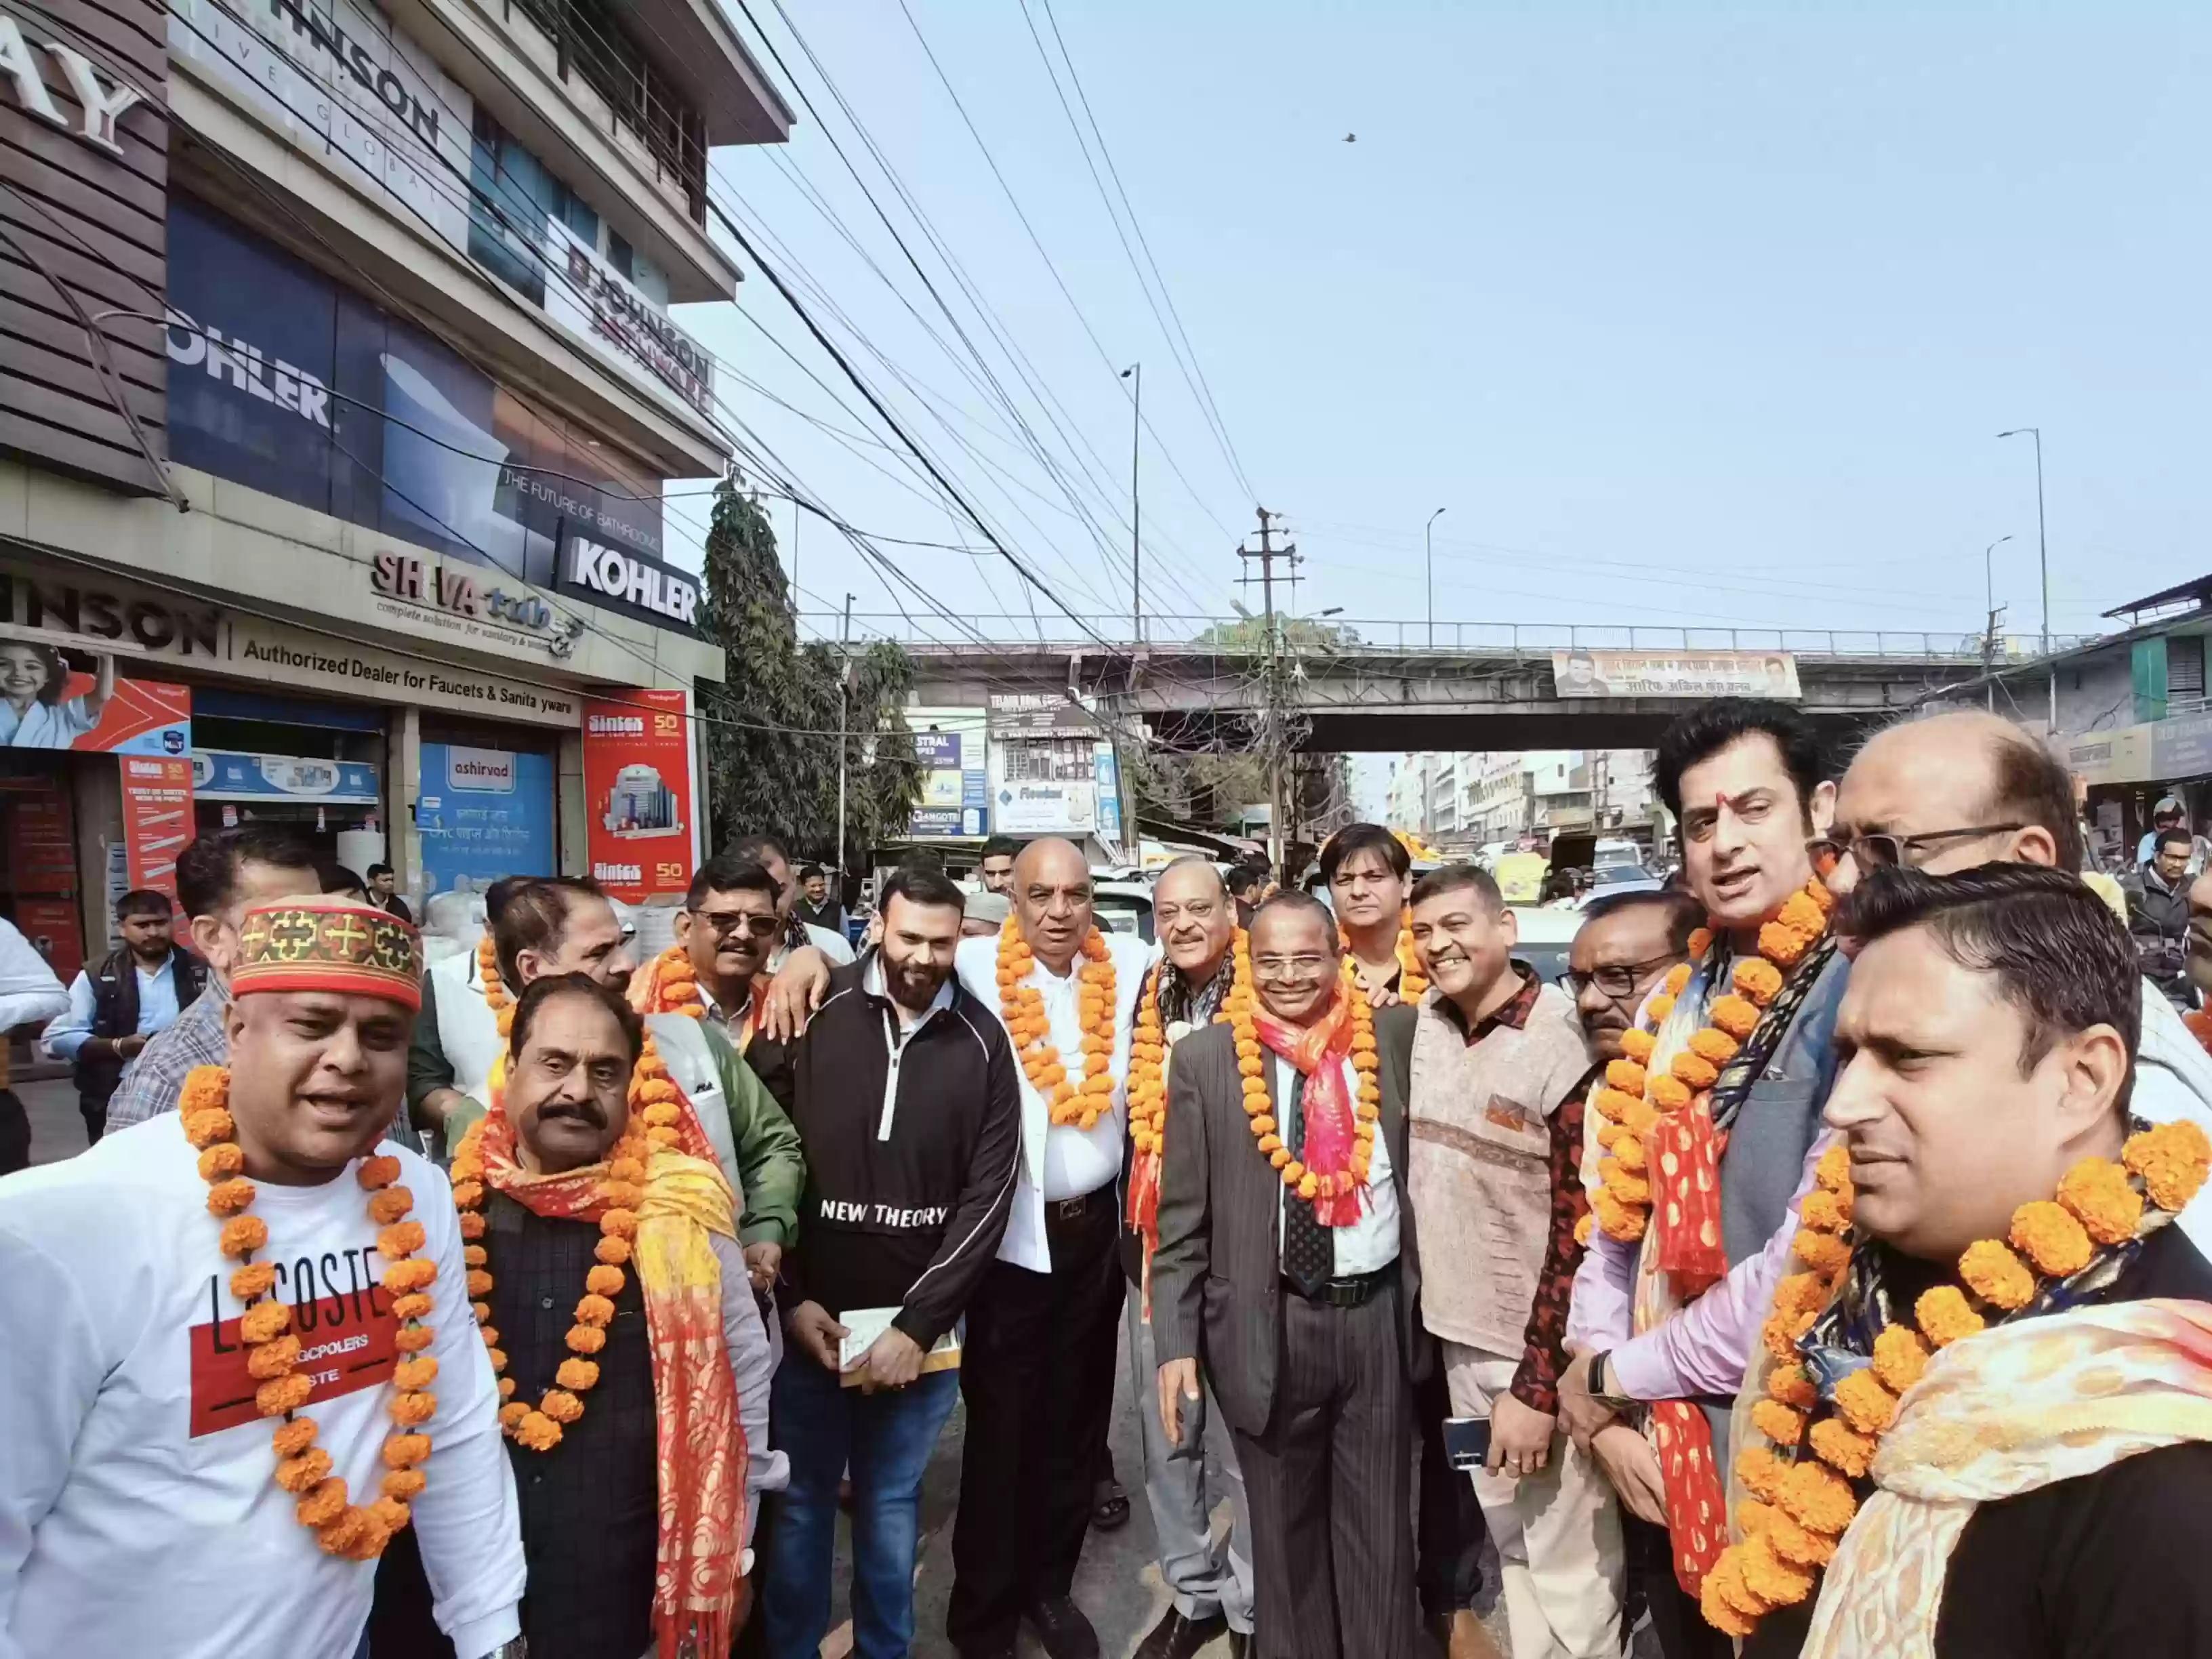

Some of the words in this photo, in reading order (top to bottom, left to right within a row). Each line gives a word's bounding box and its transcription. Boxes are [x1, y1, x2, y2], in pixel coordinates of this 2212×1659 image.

[504, 468, 529, 493] THE
[531, 480, 577, 516] FUTURE
[579, 504, 594, 522] OF
[571, 536, 697, 627] KOHLER
[377, 602, 421, 620] complete
[423, 614, 462, 630] solution
[243, 639, 348, 676] Authorized
[352, 659, 400, 684] Dealer
[404, 670, 426, 689] for
[429, 675, 483, 699] Faucets
[487, 686, 496, 701] &
[500, 688, 537, 708] Sanita
[655, 715, 677, 729] 50
[455, 760, 508, 777] ashirvad
[656, 863, 682, 878] 50
[821, 1199, 868, 1223] NEW
[874, 1204, 948, 1228] THEORY
[211, 1246, 387, 1354] LCOSTE
